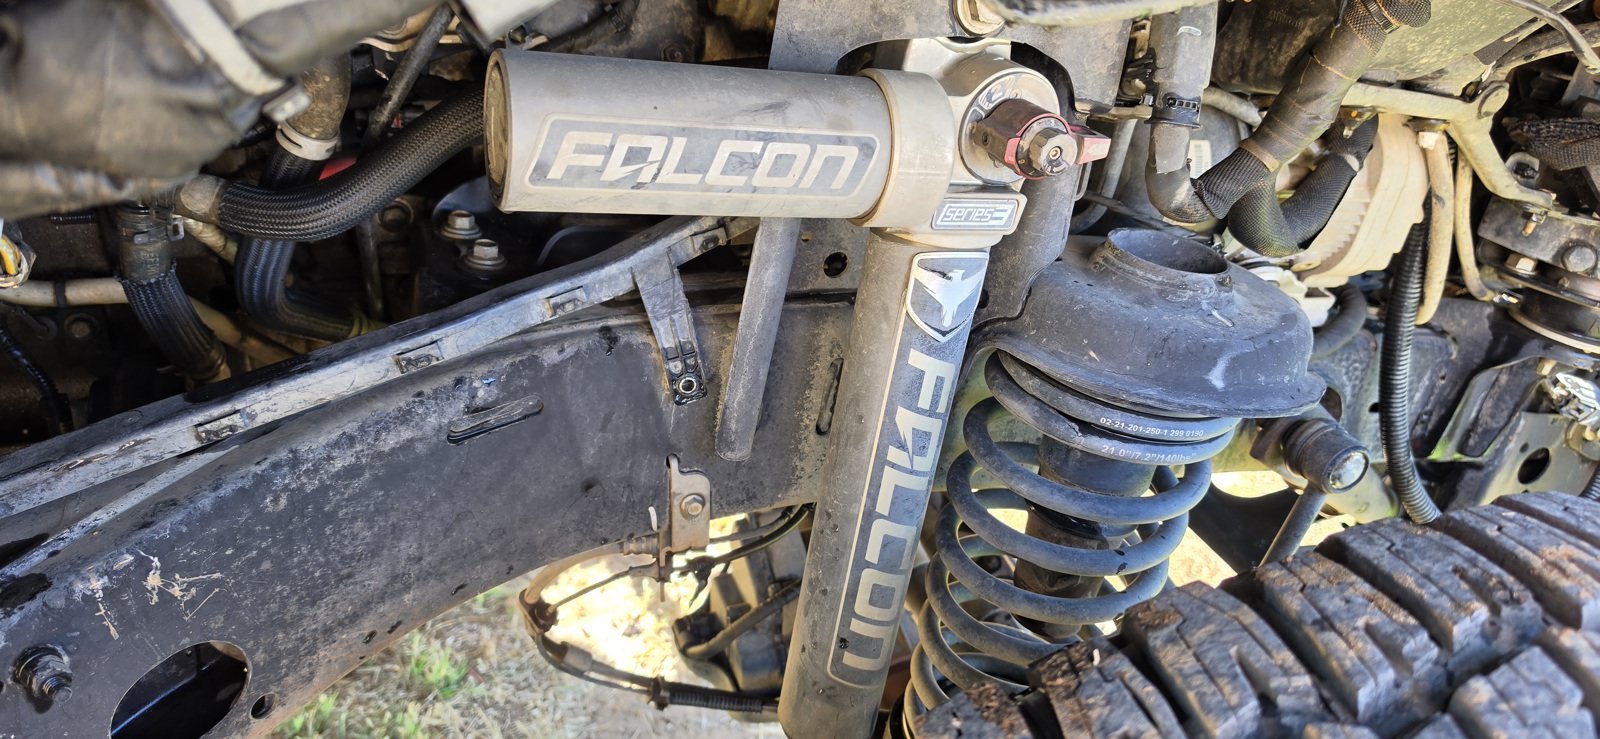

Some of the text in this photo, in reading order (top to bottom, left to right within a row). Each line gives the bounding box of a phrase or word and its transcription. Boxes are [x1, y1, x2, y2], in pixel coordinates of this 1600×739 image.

[546, 130, 859, 190] FALCON
[1099, 417, 1168, 436] 02-21-201-250-1
[1169, 429, 1184, 437] 299
[842, 347, 957, 673] FALCON
